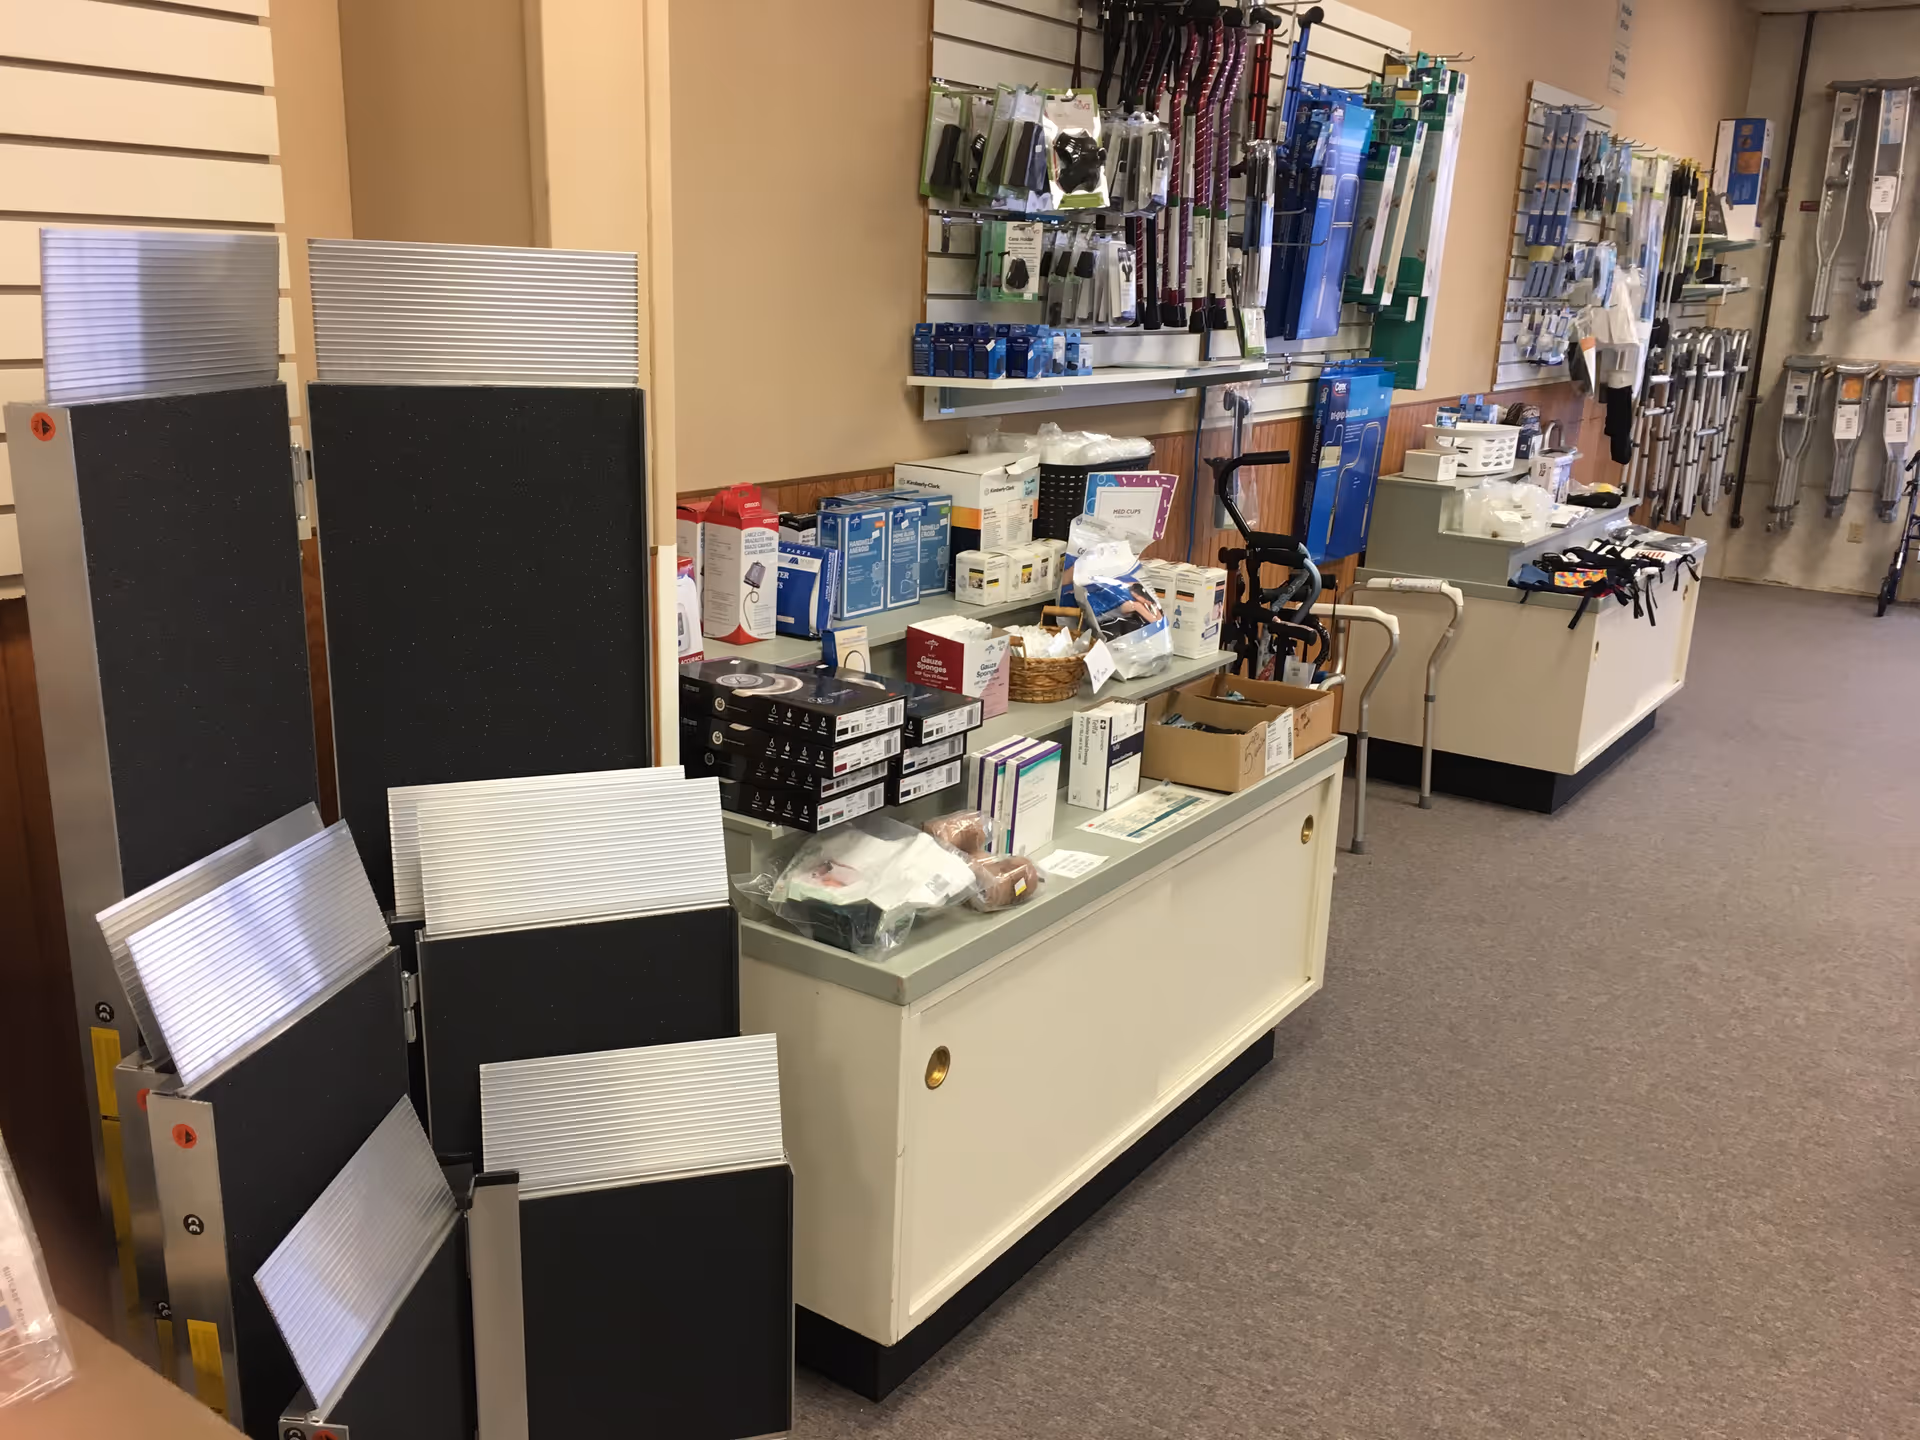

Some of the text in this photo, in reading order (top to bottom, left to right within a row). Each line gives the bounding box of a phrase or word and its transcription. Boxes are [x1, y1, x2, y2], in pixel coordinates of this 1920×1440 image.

[906, 480, 941, 490] Kimberly-Clark
[680, 654, 703, 664] ACCURACY
[920, 656, 943, 666] Gauze
[916, 661, 947, 673] Sponges
[980, 662, 997, 671] Gauze
[976, 667, 999, 679] Sponges
[1091, 719, 1099, 734] Telfa
[187, 1217, 200, 1233] CE
